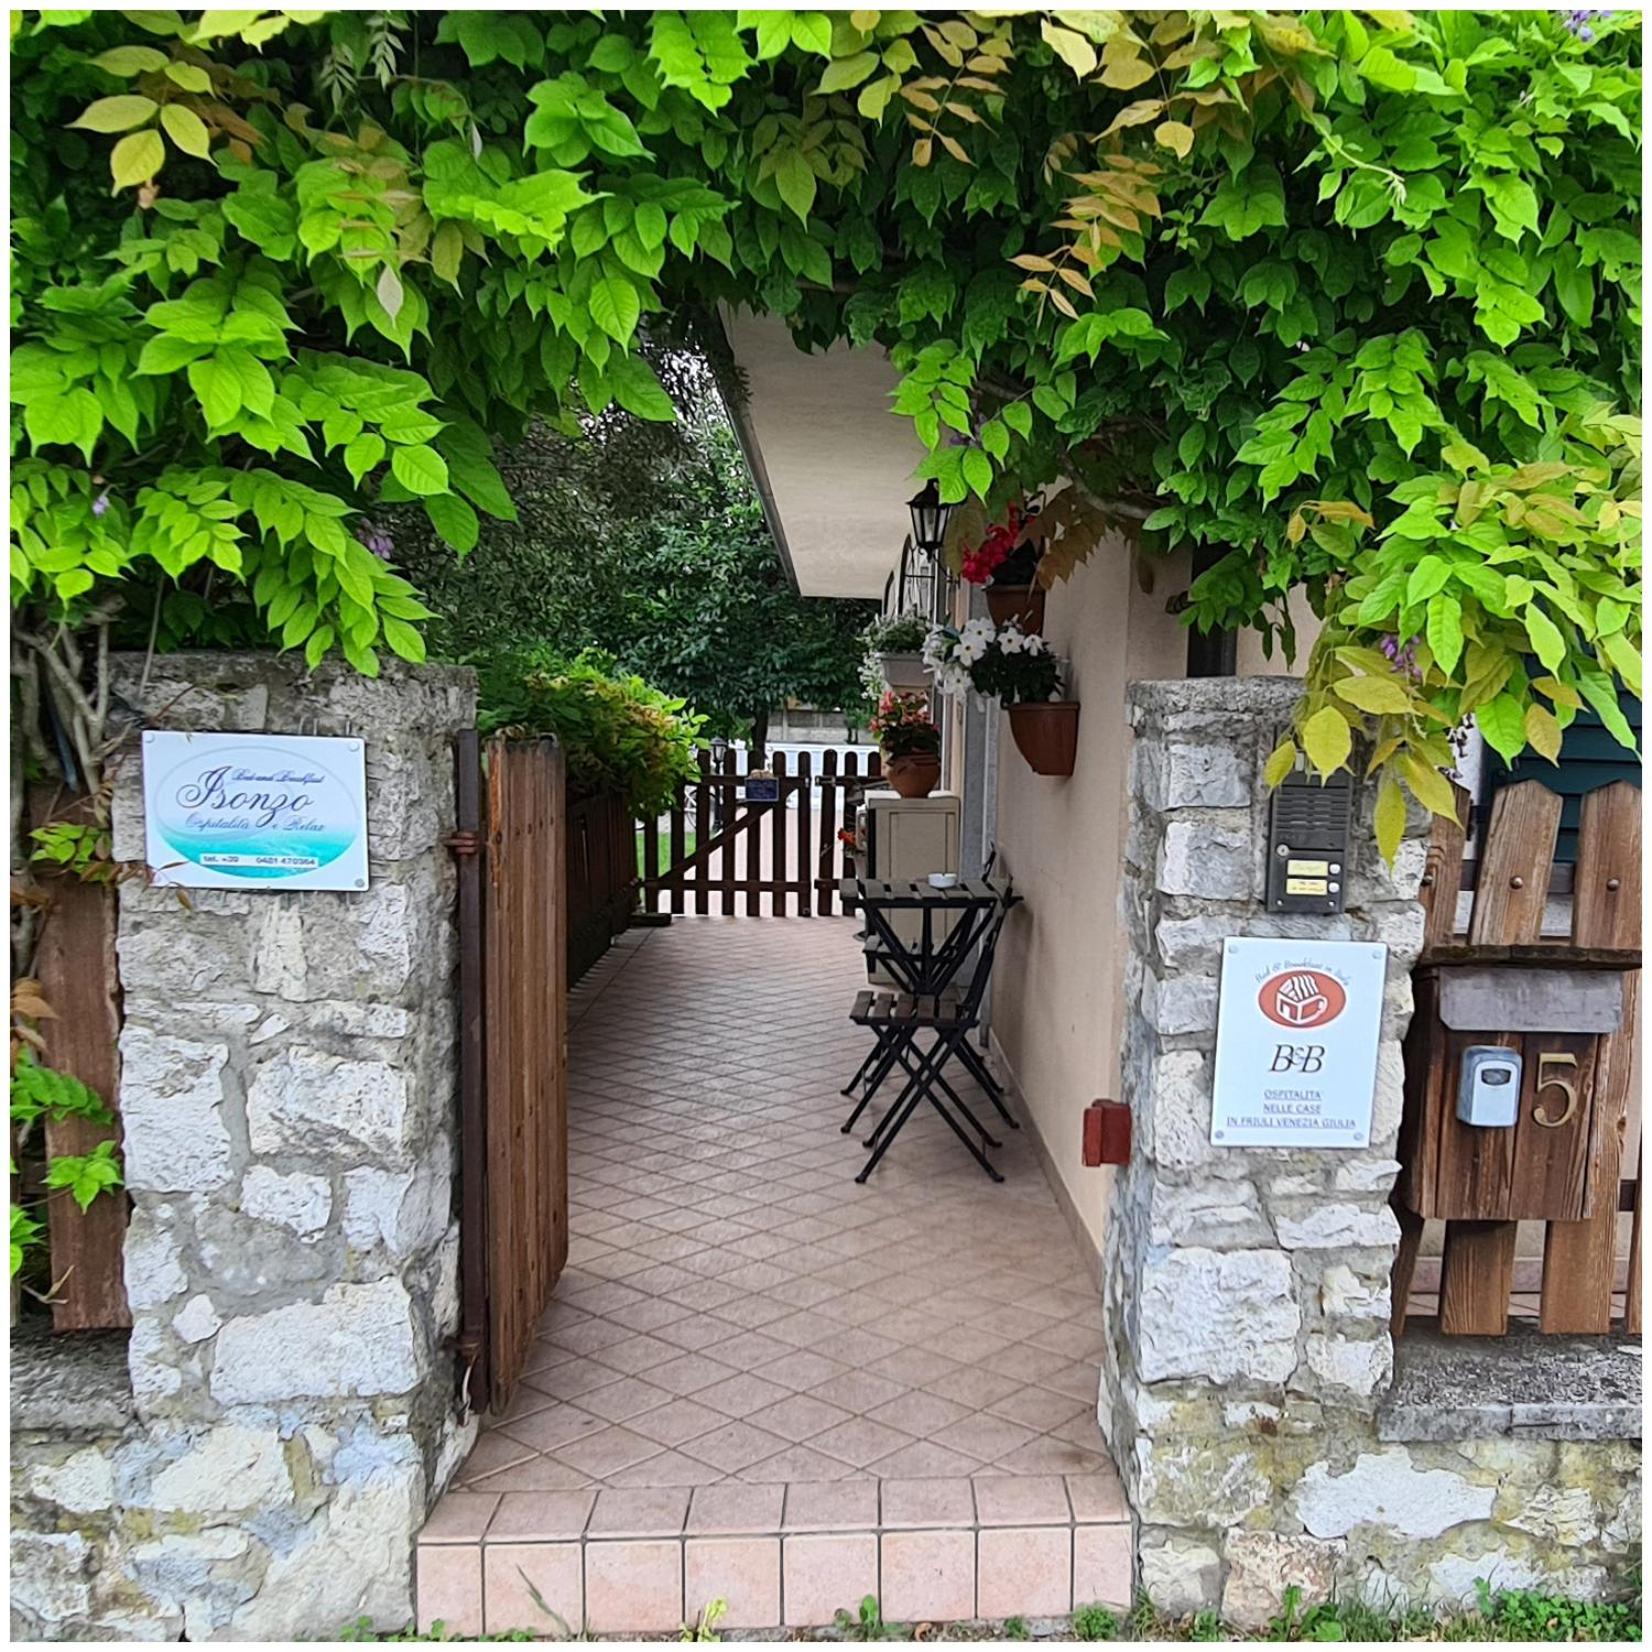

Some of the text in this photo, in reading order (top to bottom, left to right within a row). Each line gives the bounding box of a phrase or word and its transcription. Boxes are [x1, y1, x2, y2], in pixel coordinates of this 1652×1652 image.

[176, 765, 314, 828] Isonzo
[1269, 1043, 1326, 1074] B&B
[1533, 1052, 1577, 1127] 5
[1227, 1117, 1356, 1130] IN FRIULI VENEZIA GIULIA
[1263, 1104, 1321, 1115] NELLE CASE
